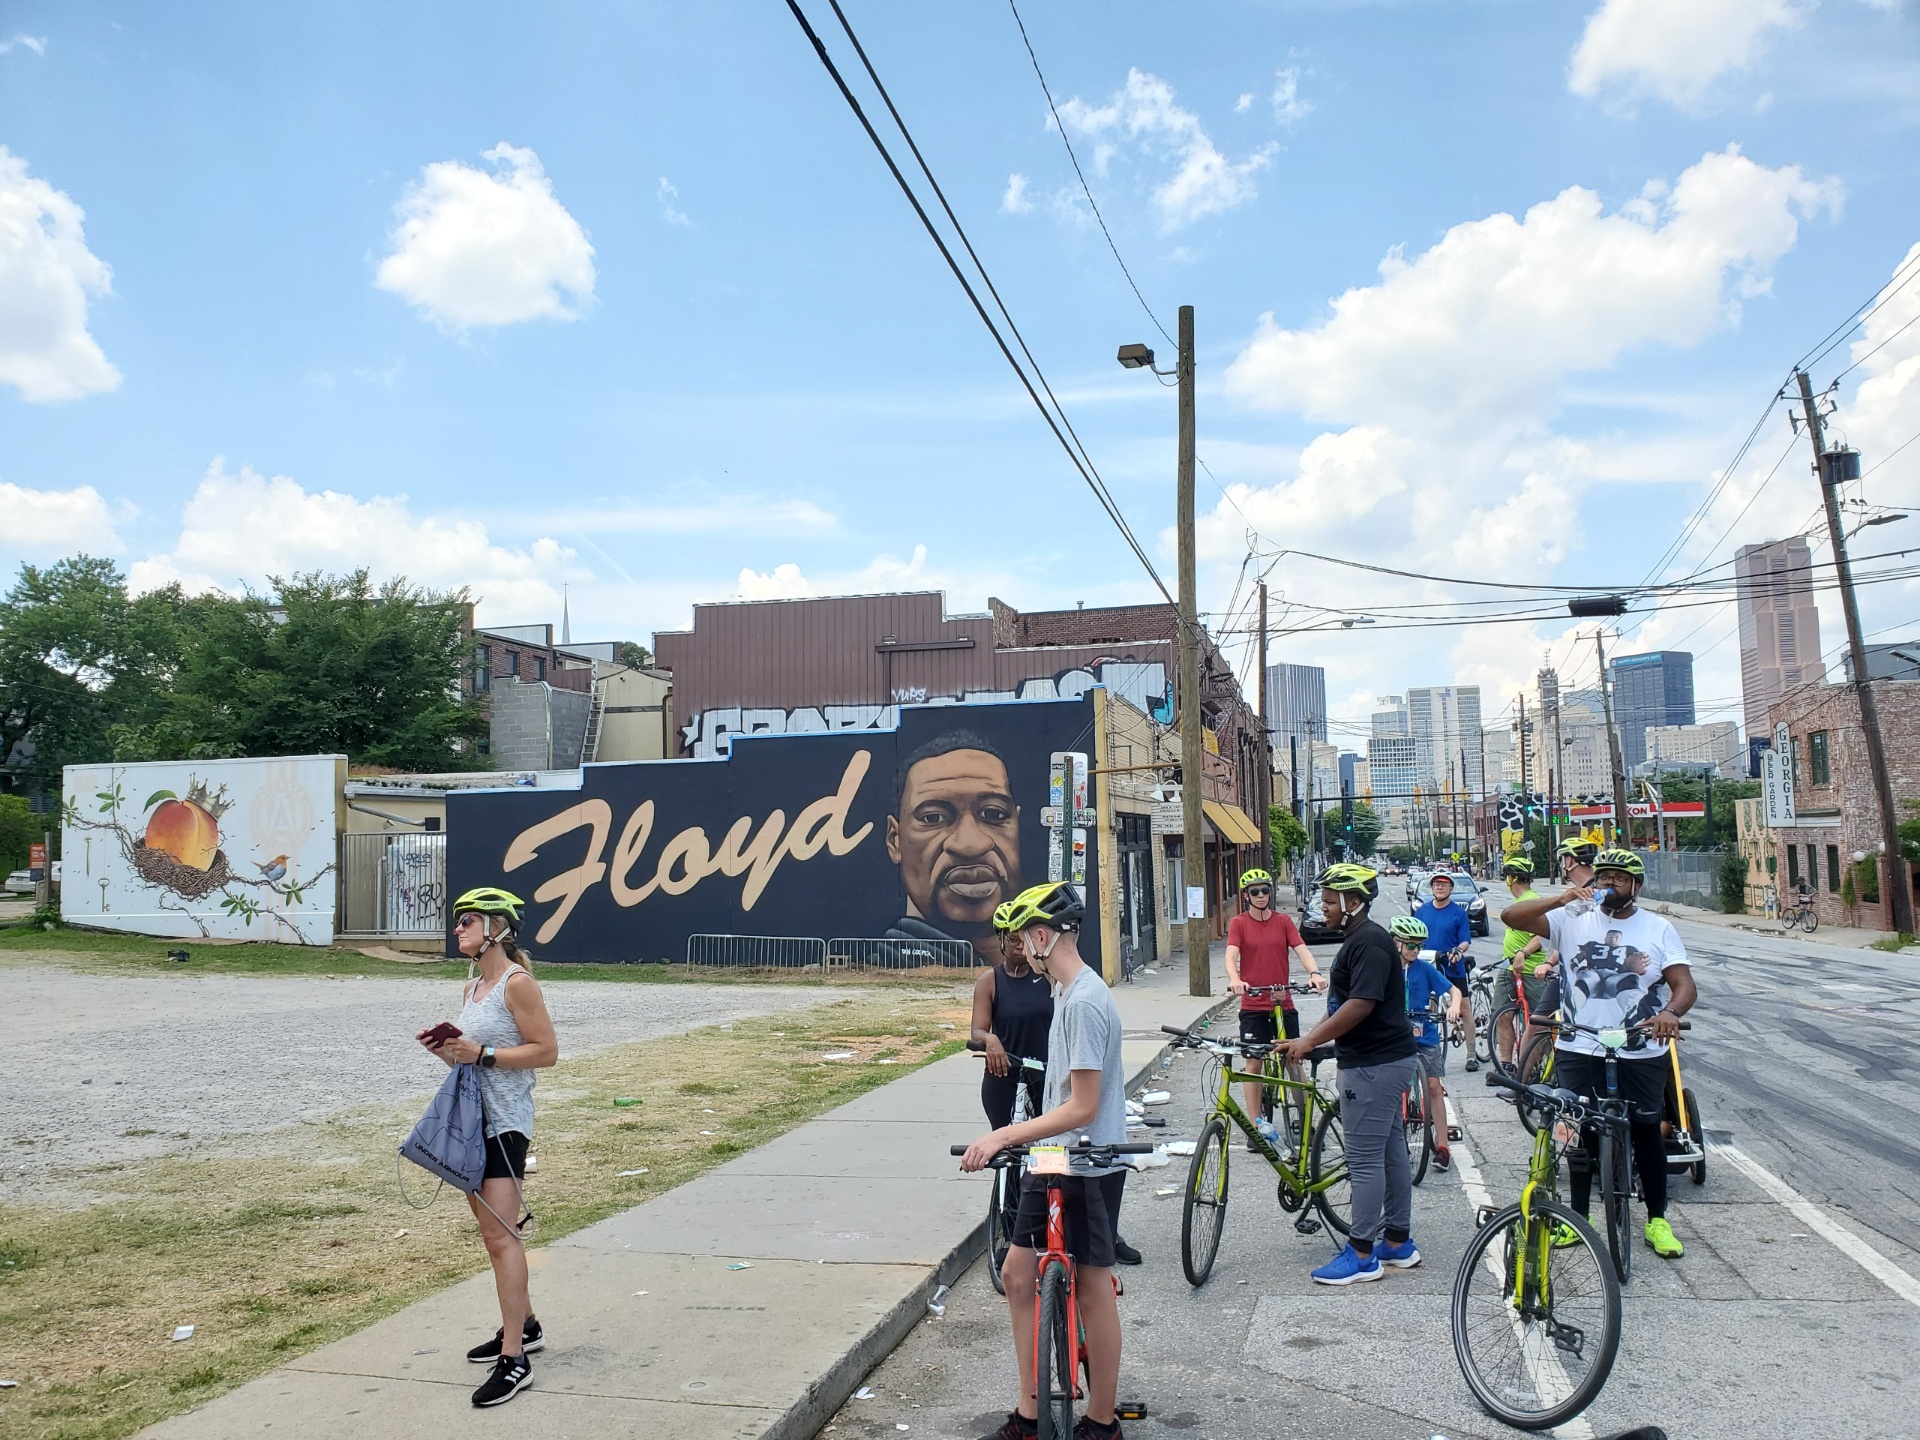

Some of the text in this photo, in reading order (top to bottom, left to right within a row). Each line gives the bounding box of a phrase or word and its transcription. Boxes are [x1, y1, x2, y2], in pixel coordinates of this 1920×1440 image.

[1779, 729, 1793, 819] GEORGIA
[1769, 782, 1777, 819] GARDEN
[503, 749, 874, 945] Floyd
[1591, 944, 1627, 965] 34
[414, 1142, 470, 1182] UNDER ARMOUR
